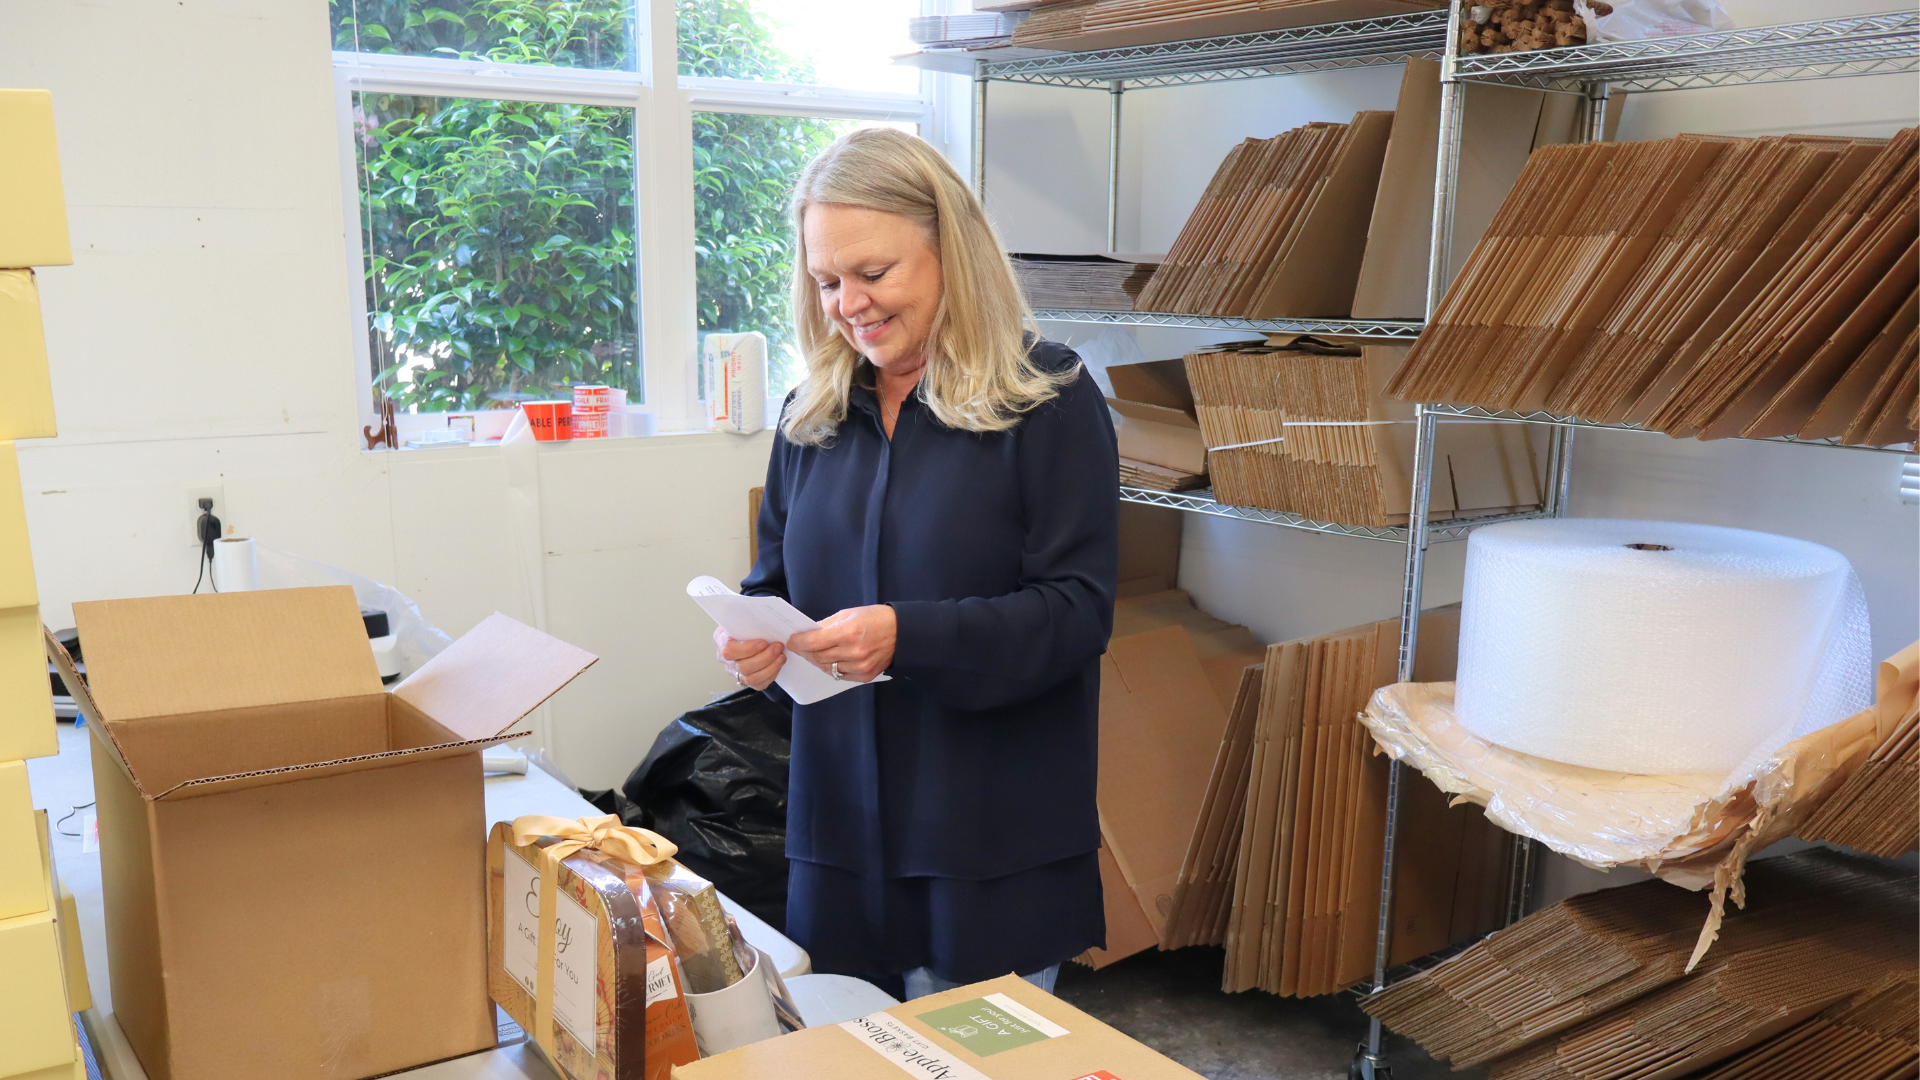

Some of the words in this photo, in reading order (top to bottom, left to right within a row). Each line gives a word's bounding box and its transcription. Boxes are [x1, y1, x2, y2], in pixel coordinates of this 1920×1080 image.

[530, 417, 552, 428] ABLE
[526, 876, 573, 954] Eoy
[518, 922, 524, 935] A
[524, 927, 536, 947] Gift
[554, 953, 564, 971] or
[565, 962, 579, 985] You
[968, 1010, 999, 1030] GIFT
[981, 1006, 1003, 1018] you!
[998, 1017, 1013, 1025] for
[853, 1017, 898, 1045] Bloss
[885, 1021, 915, 1040] BASKETS
[998, 1028, 1012, 1036] A
[912, 1038, 929, 1050] GIFT
[903, 1049, 958, 1080] Apple
